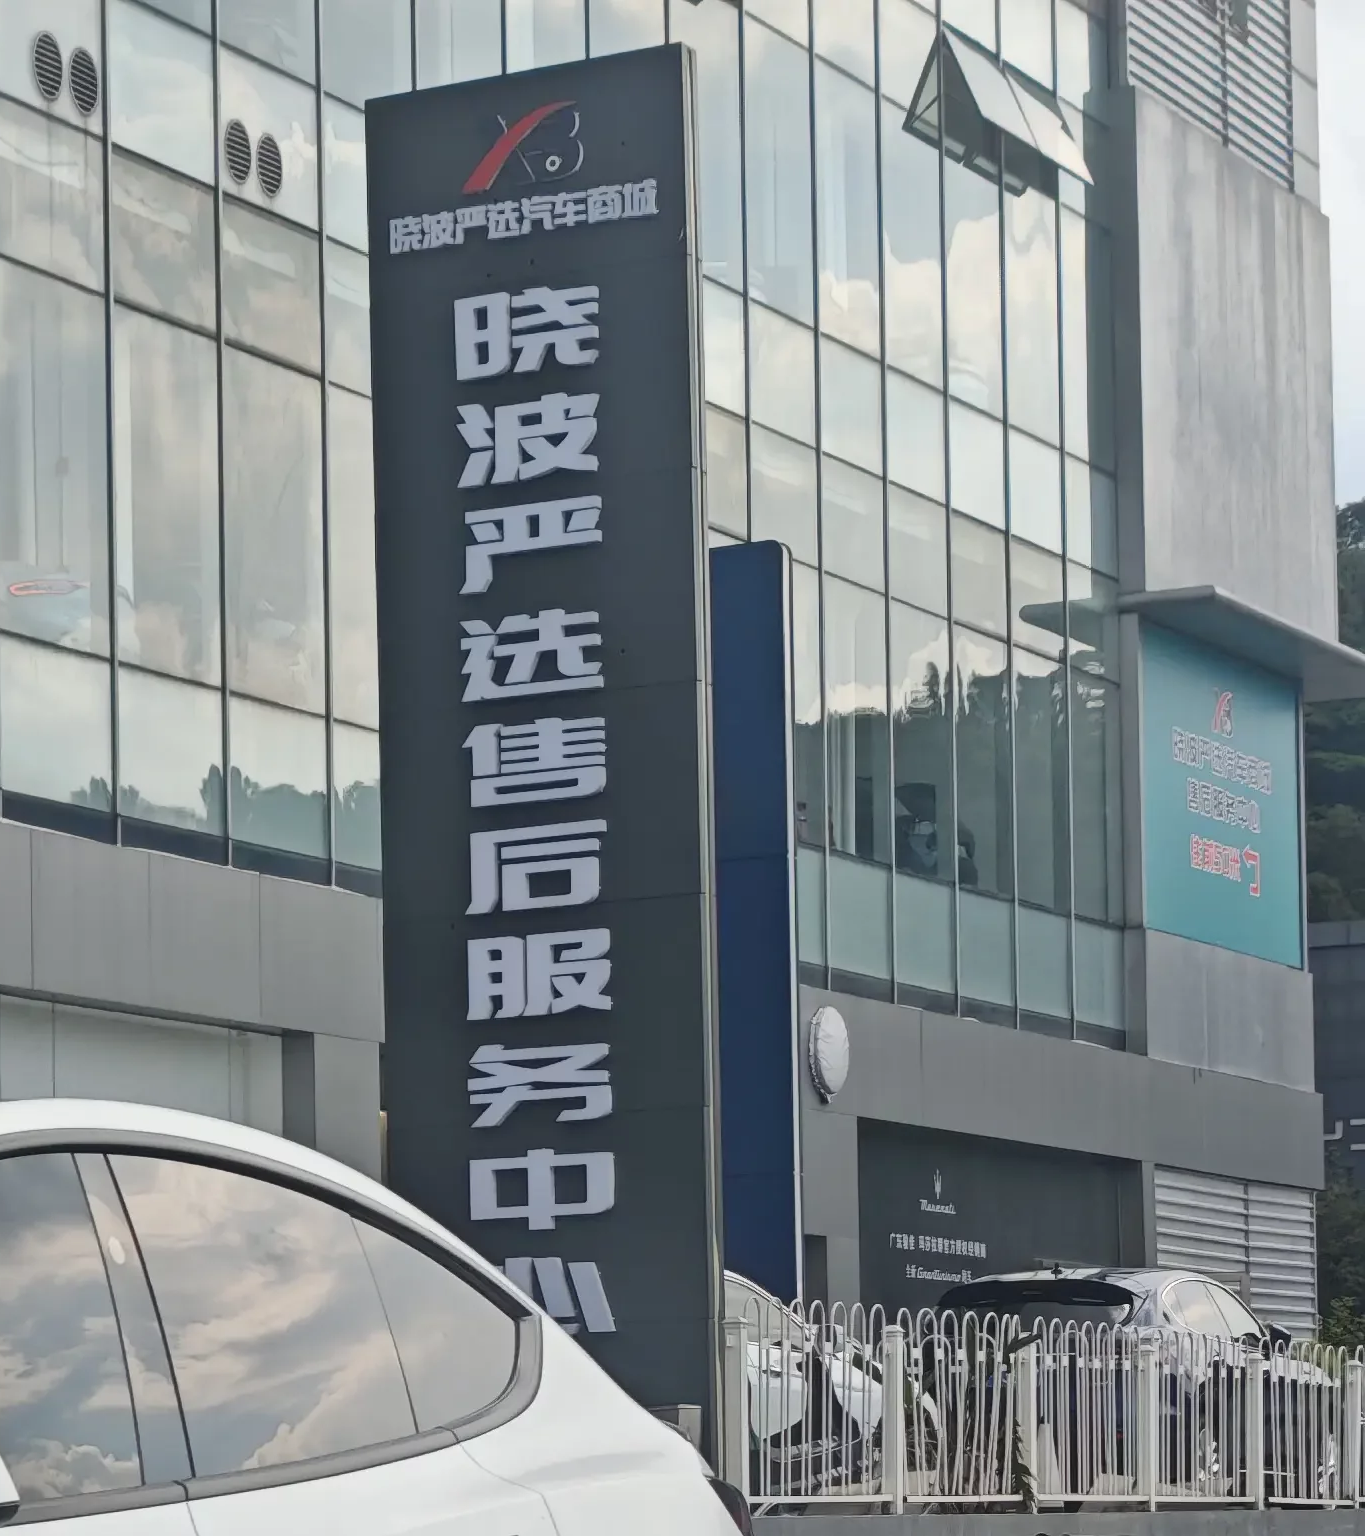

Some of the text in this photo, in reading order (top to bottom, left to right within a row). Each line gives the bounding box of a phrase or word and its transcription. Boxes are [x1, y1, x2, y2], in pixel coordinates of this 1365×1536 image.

[388, 177, 660, 255] 晓波严选汽车商城
